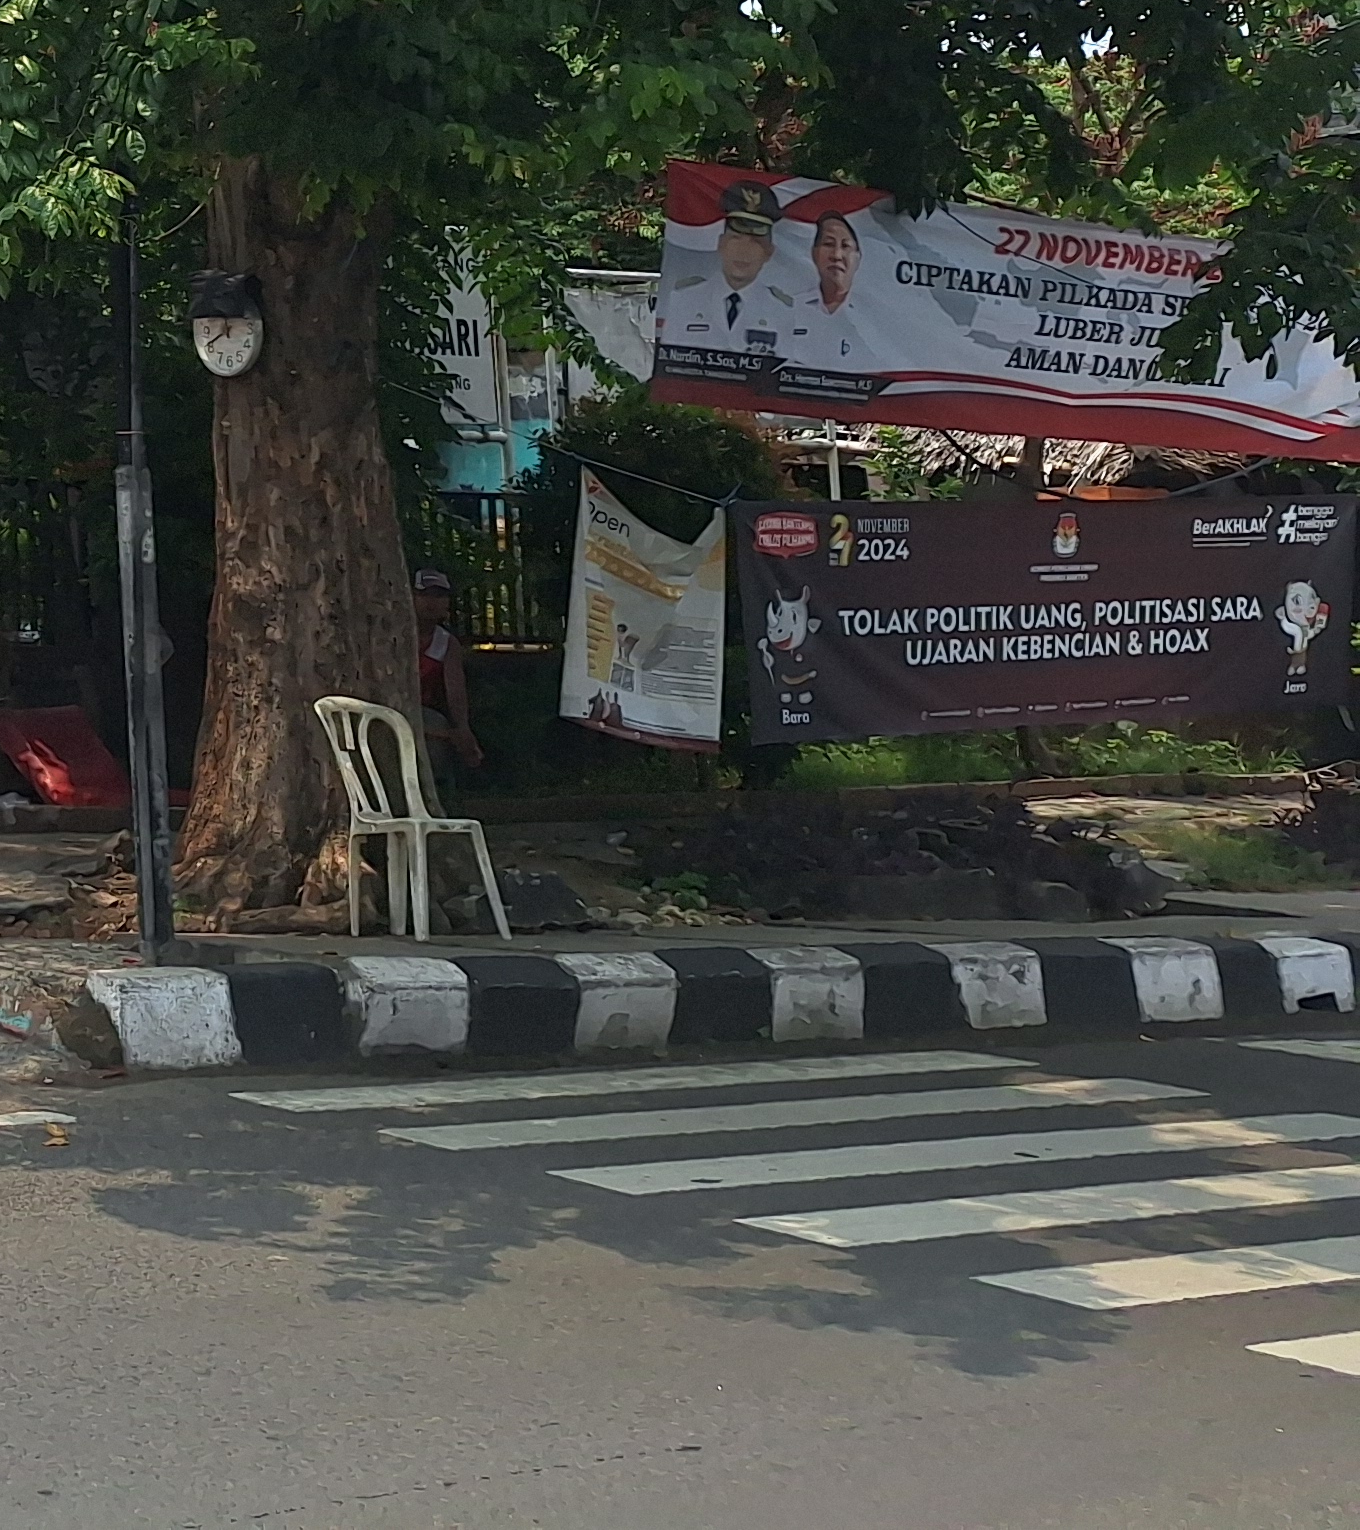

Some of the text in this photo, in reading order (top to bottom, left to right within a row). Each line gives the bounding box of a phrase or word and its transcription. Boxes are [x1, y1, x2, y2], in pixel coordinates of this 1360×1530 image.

[993, 226, 1032, 257] 27
[1034, 231, 1203, 278] NOVEMBER
[896, 260, 1032, 302] CIPTAKAN
[1040, 280, 1154, 315] PILKADA
[1034, 313, 1126, 346] LUBER
[1004, 347, 1084, 376] AMAN
[1088, 353, 1148, 381] DAN
[857, 518, 910, 533] NOVEMBER
[1192, 514, 1269, 536] BerAKHLAK
[857, 538, 910, 561] 2024
[838, 596, 1263, 636] TOLAK POLITIK UANG, POLITISASI SARA
[905, 627, 1211, 666] UJARAN KEBENCIAN & HOAX
